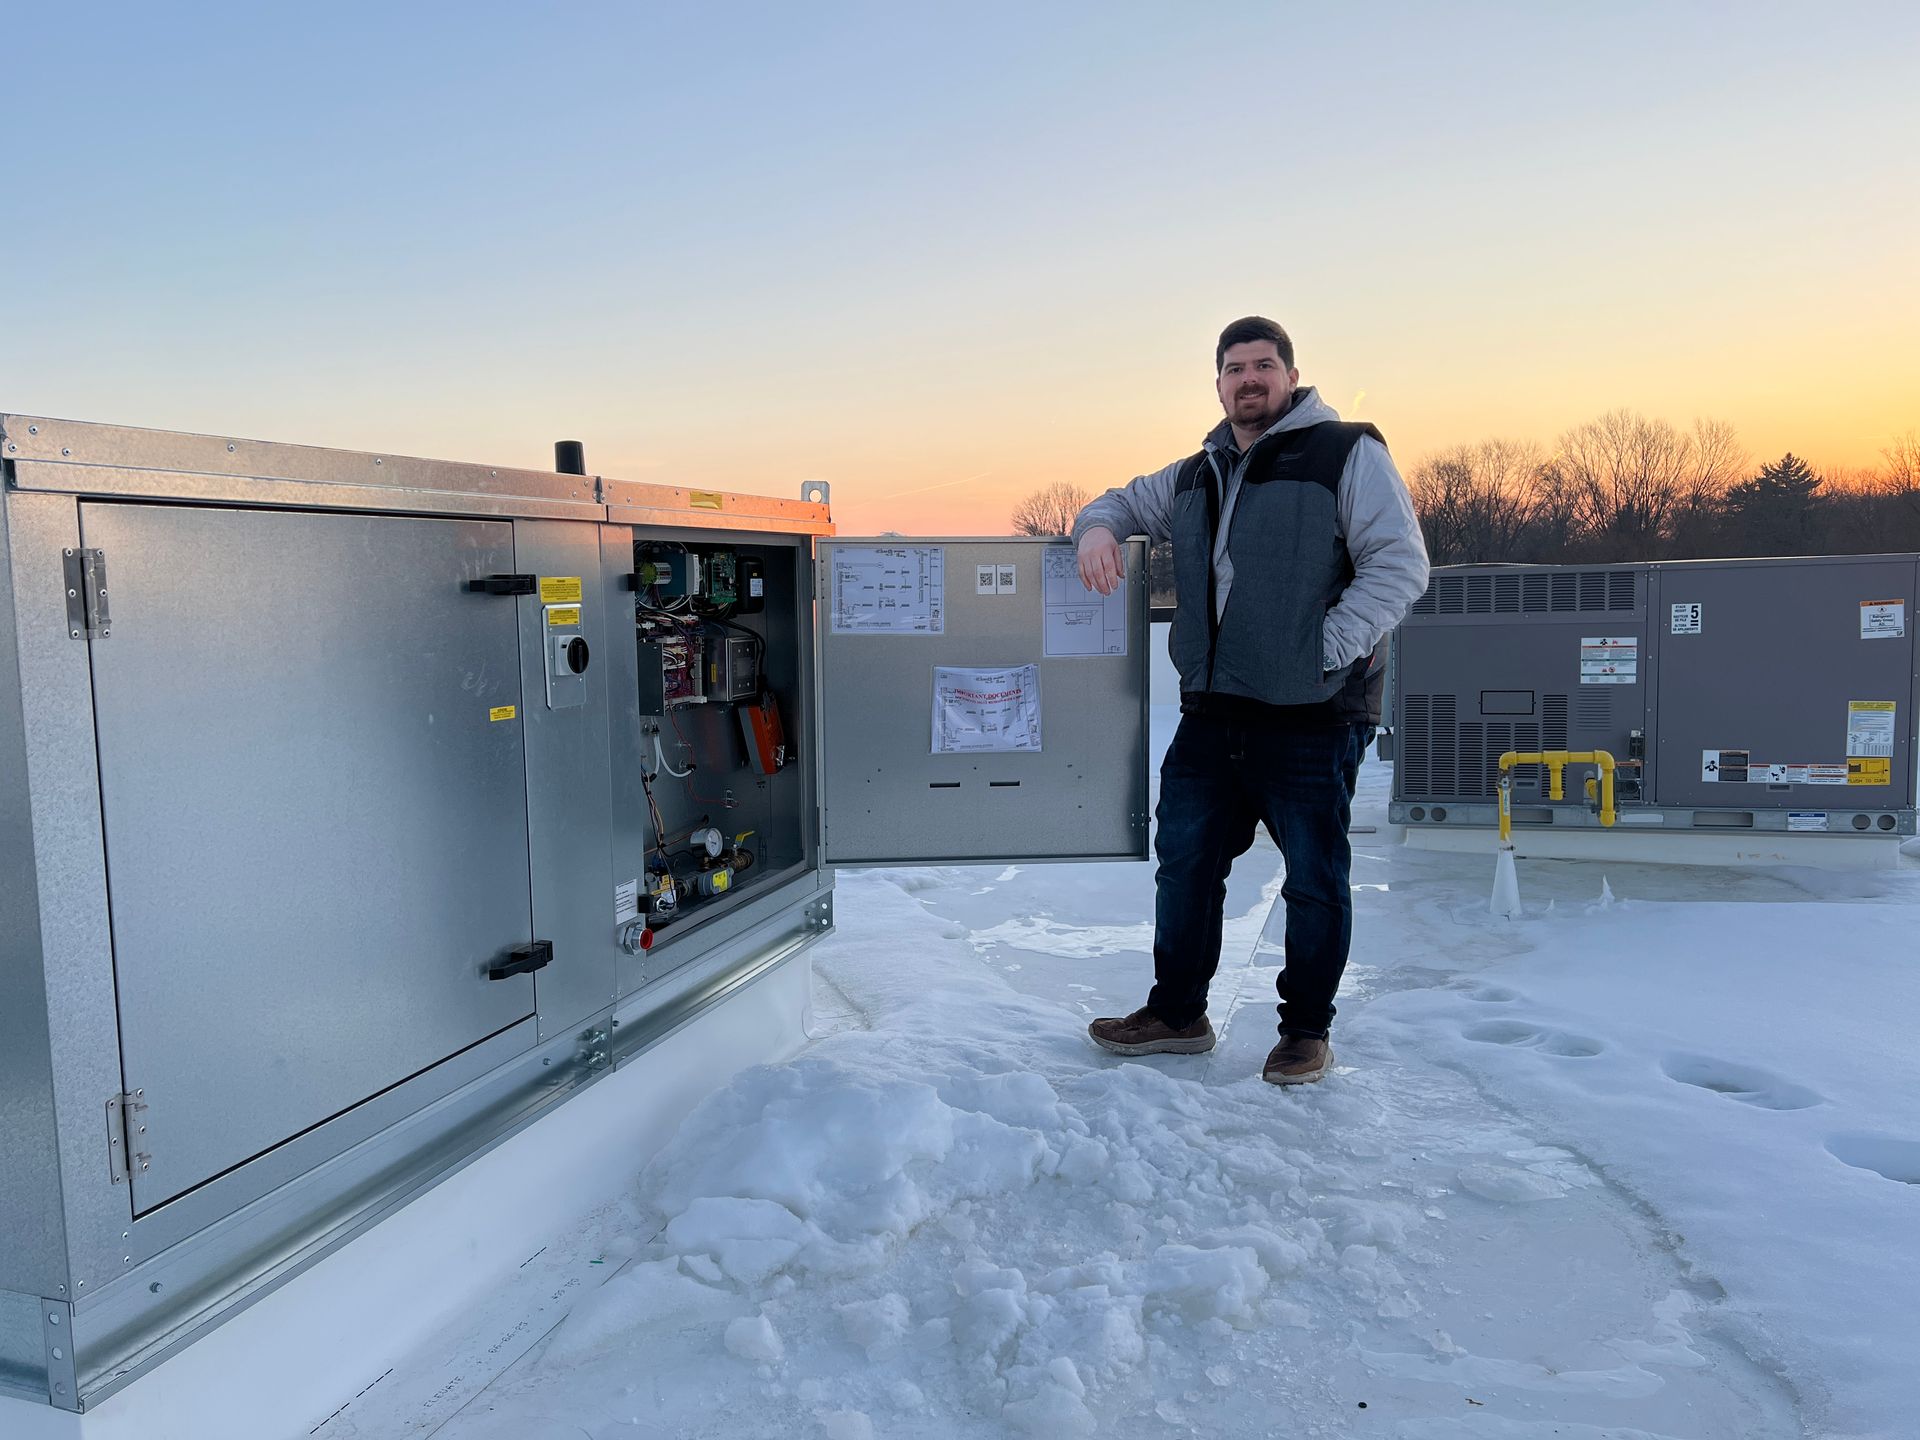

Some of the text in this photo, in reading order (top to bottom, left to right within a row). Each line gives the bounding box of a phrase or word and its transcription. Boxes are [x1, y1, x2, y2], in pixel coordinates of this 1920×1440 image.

[1691, 605, 1699, 619] 5
[954, 688, 1022, 699] IMPORTANT DOCUMENTS
[423, 1376, 465, 1407] ELEVATE
